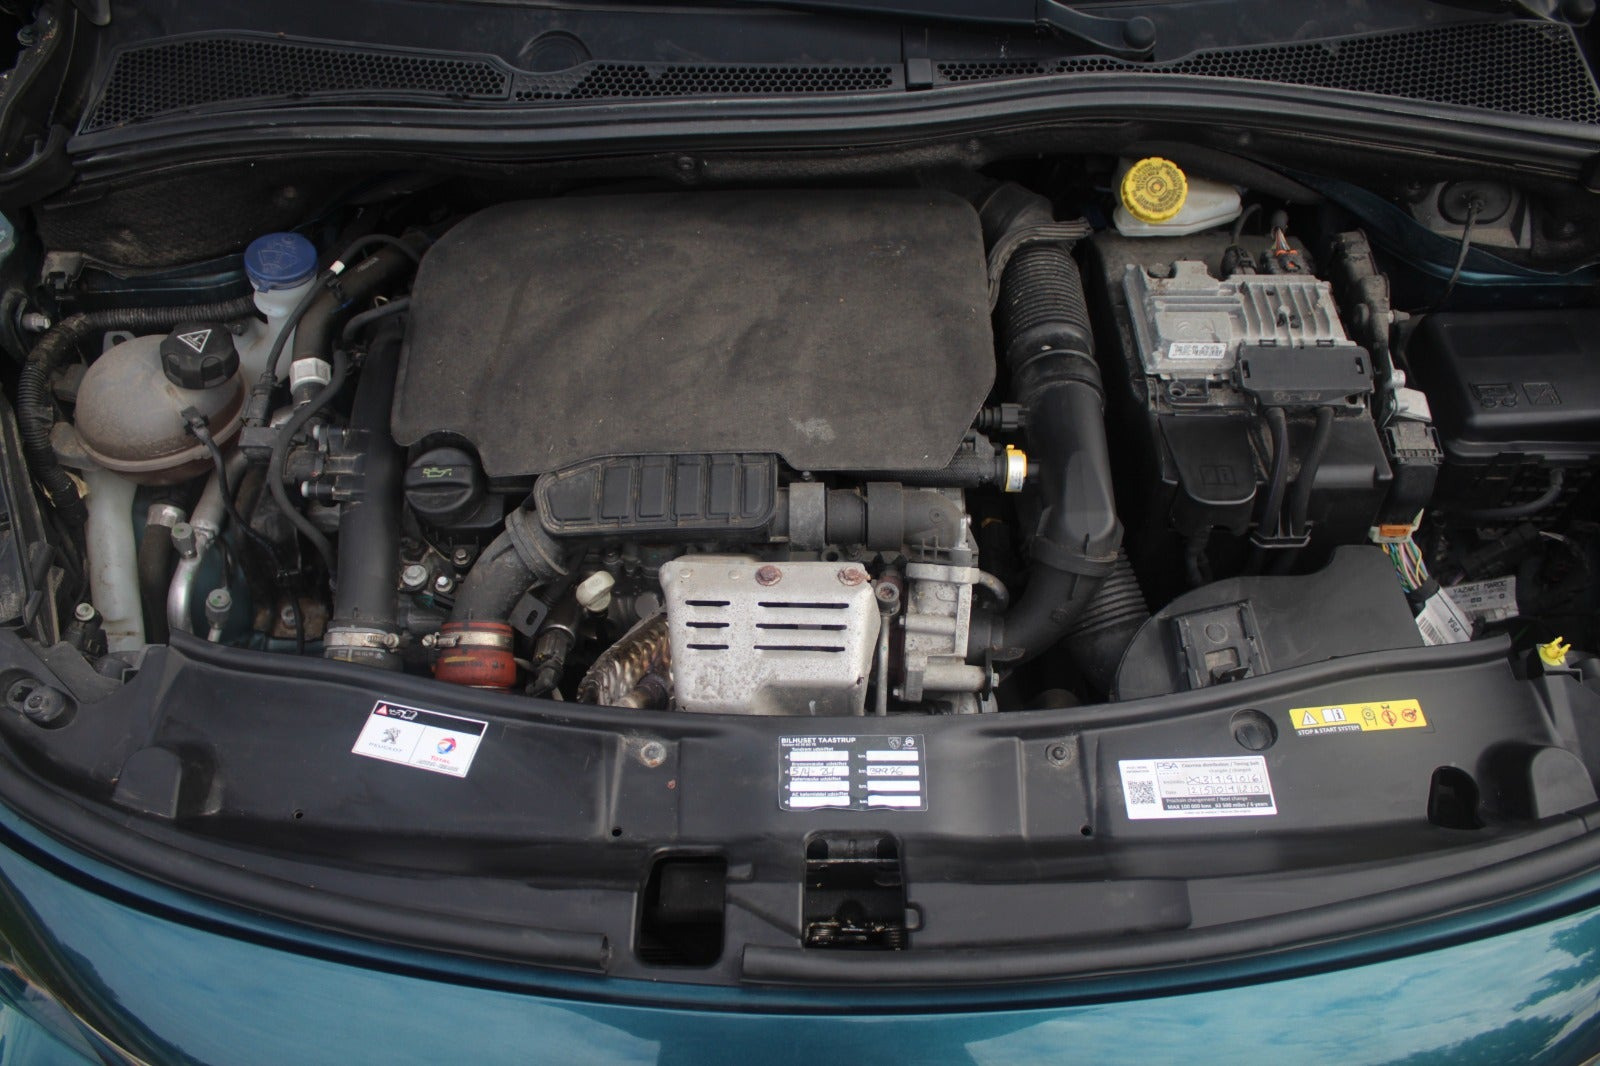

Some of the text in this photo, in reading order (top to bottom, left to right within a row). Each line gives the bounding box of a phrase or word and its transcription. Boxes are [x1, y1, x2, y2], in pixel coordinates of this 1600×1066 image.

[1453, 585, 1480, 593] YAZAKI
[1483, 581, 1506, 589] MAROC
[1448, 617, 1460, 633] PSA
